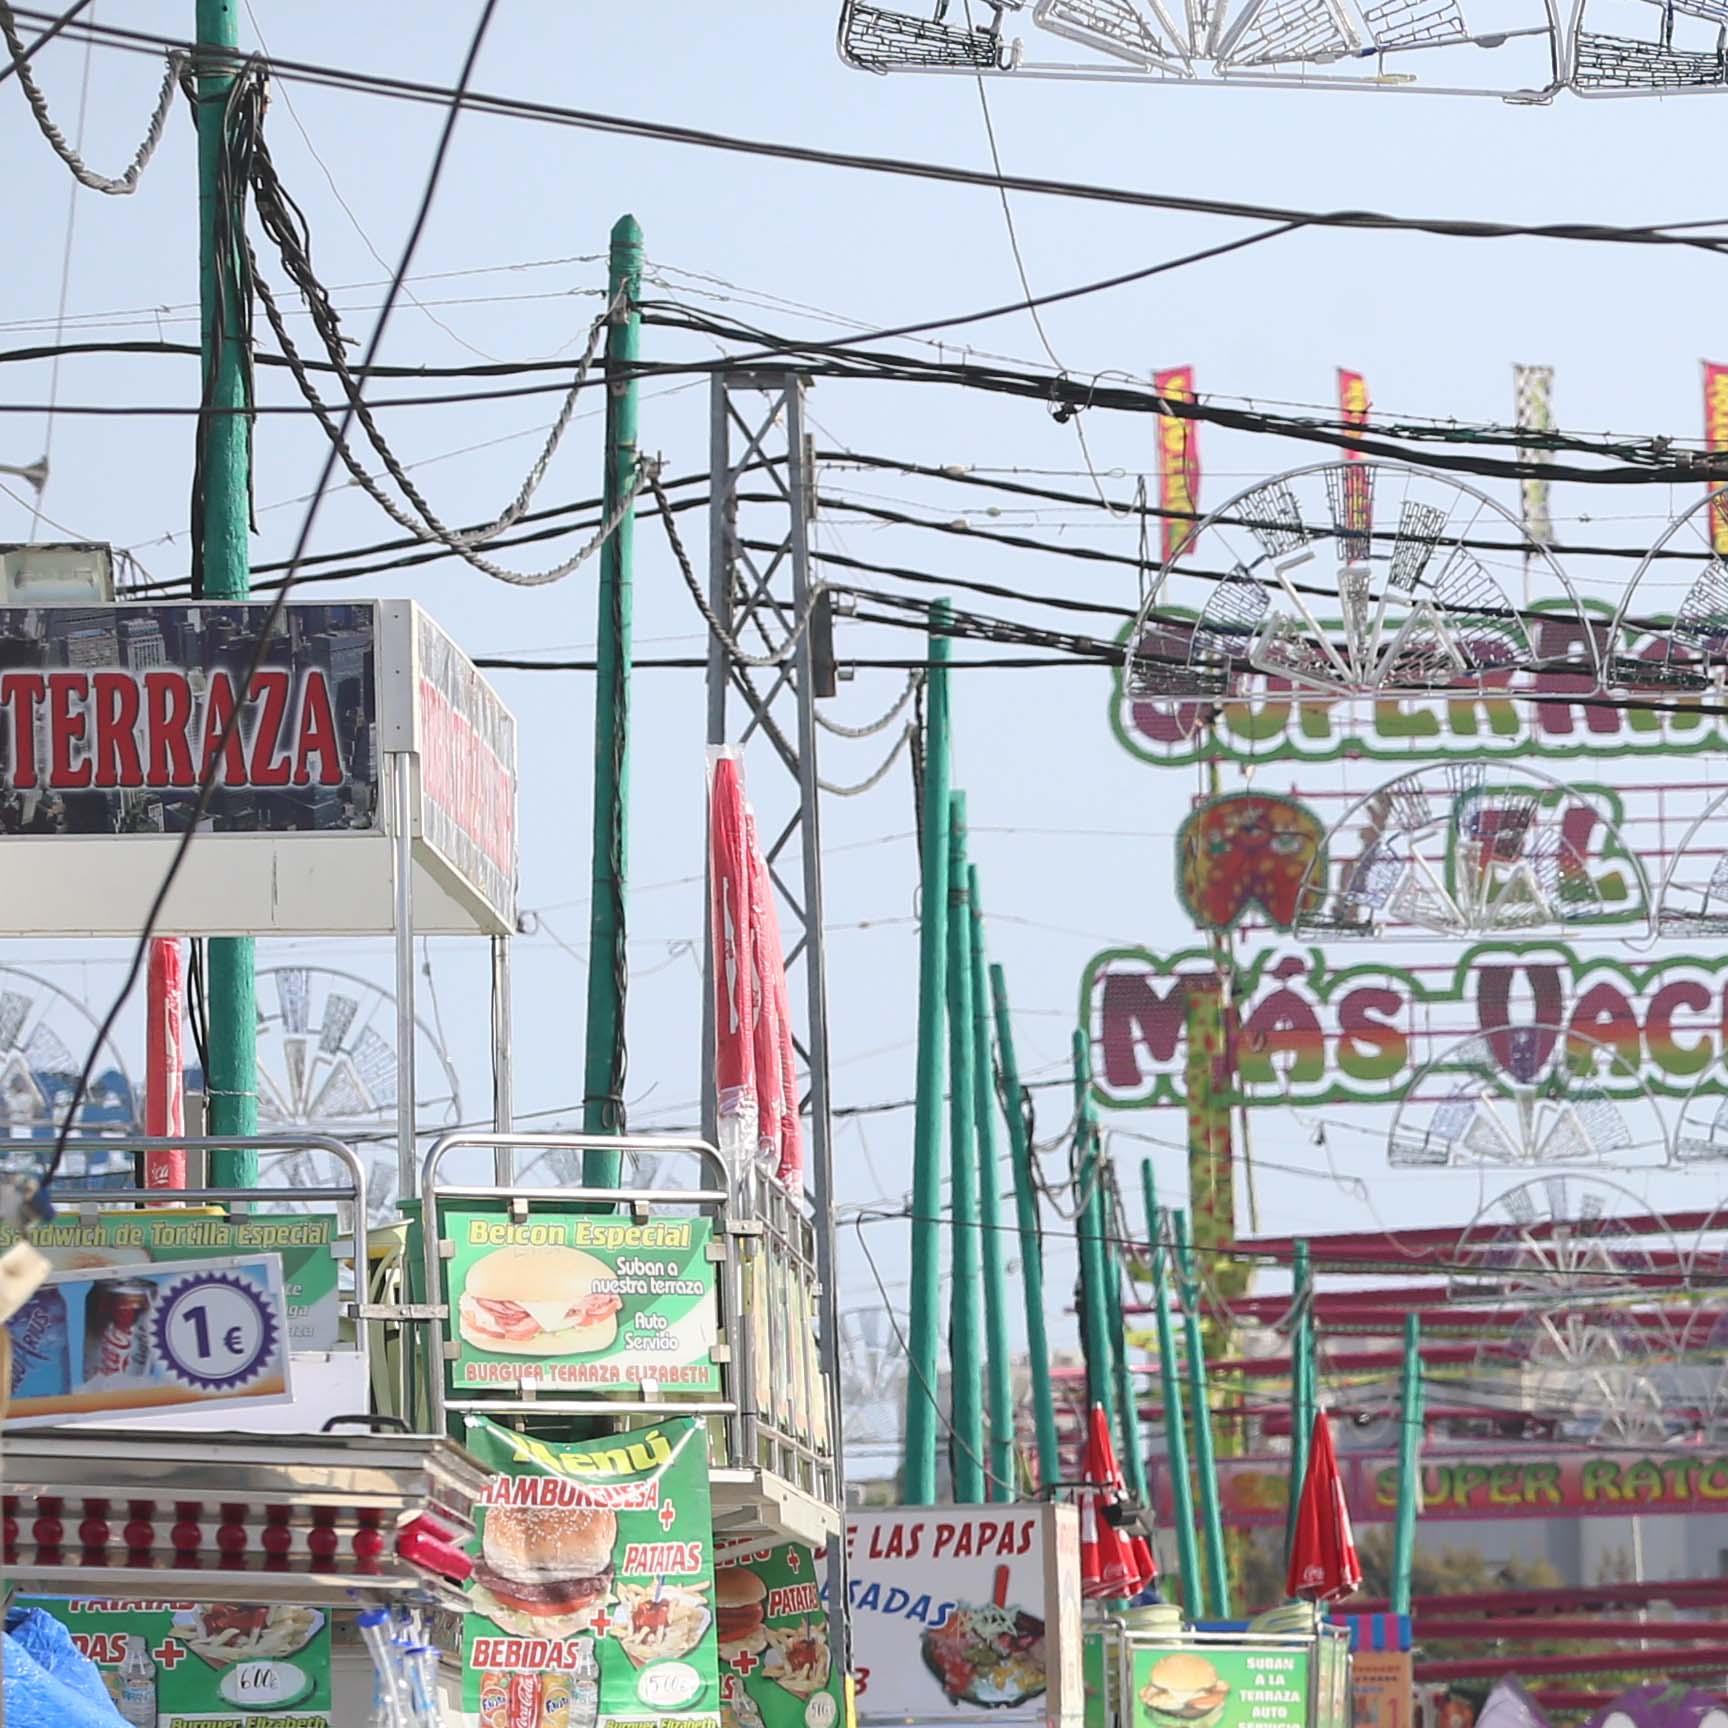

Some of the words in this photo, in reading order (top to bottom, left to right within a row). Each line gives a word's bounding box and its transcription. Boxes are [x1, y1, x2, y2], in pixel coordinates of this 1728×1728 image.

[2, 671, 345, 789] TERRAZA
[1103, 956, 1407, 1087] MÁS
[115, 1223, 145, 1247] de
[152, 1222, 231, 1247] Tortilla
[239, 1221, 331, 1249] Especial
[469, 1220, 565, 1246] Beicon
[576, 1220, 692, 1250] Especial
[616, 1257, 665, 1276] Suban
[668, 1261, 678, 1275] a
[591, 1277, 647, 1295] nuestra
[651, 1278, 704, 1295] terraza
[182, 1305, 211, 1359] 1
[223, 1326, 245, 1355] €
[635, 1312, 667, 1329] Auto
[624, 1331, 679, 1351] Servicio
[626, 1365, 711, 1384] ELIZABETH
[509, 1430, 675, 1475] Menú
[1376, 1460, 1560, 1507] SUPER
[868, 1523, 924, 1559] LAS
[933, 1520, 1035, 1558] PAPAS
[625, 1545, 701, 1573] PATATAS
[473, 1640, 580, 1668] BEBIDAS
[1247, 1658, 1295, 1670] SUBAN
[1255, 1674, 1265, 1686] A
[1268, 1674, 1285, 1686] LA
[1240, 1690, 1301, 1703] TERRAZA
[1252, 1706, 1288, 1719] AUTO
